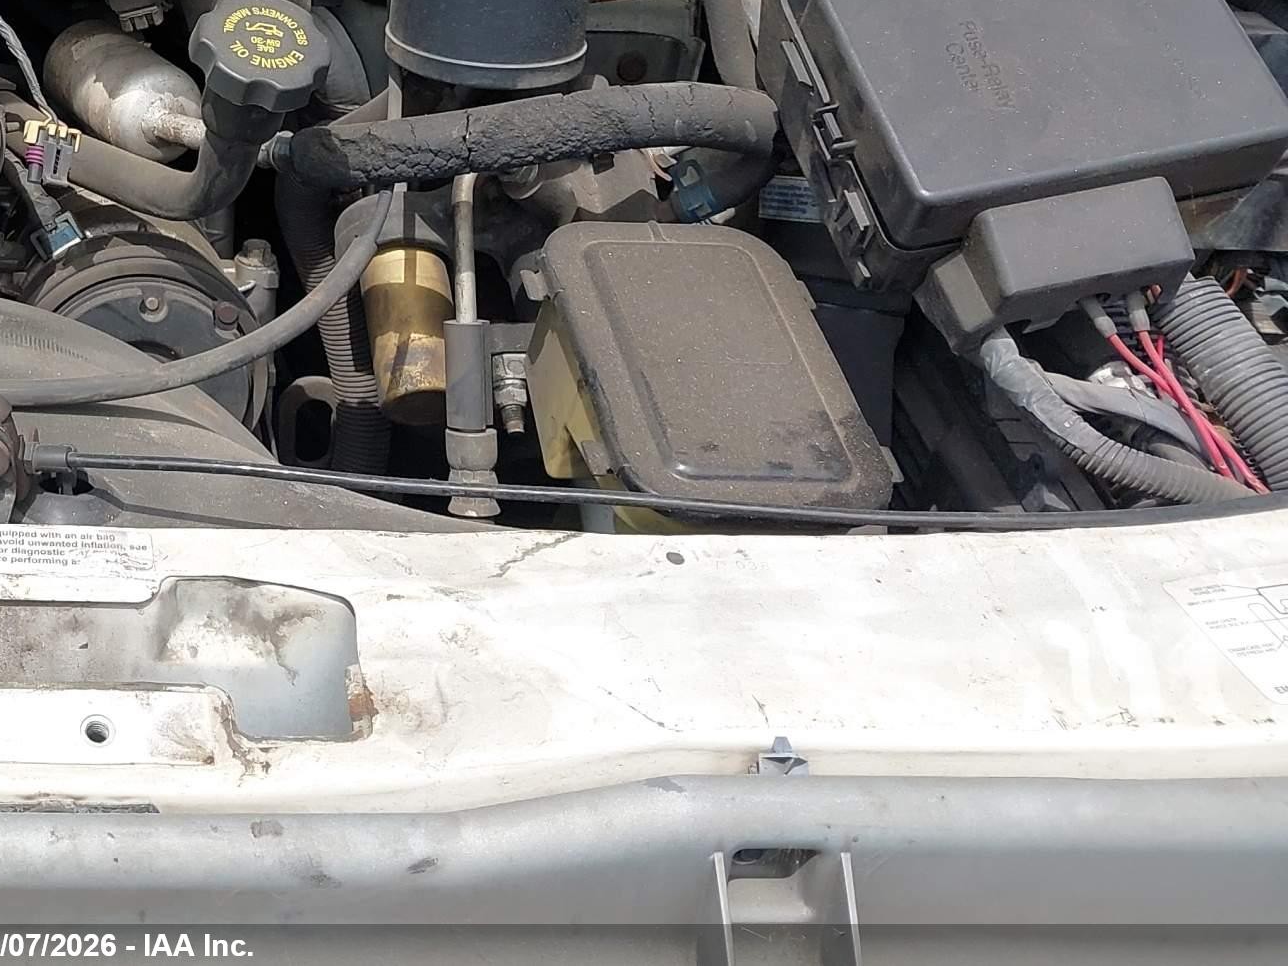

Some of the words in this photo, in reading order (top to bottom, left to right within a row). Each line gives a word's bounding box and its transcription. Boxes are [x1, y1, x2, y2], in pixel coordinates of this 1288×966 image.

[223, 8, 253, 33] MANUAL
[252, 7, 298, 29] OWNER'S
[295, 24, 310, 47] SEE
[229, 40, 250, 59] OIL
[250, 50, 306, 70] ENGINE
[27, 540, 79, 548] unwanted
[40, 531, 62, 539] with
[80, 532, 94, 540] air
[97, 533, 116, 542] bag
[10, 557, 69, 566] performing
[11, 547, 65, 557] diagnostic
